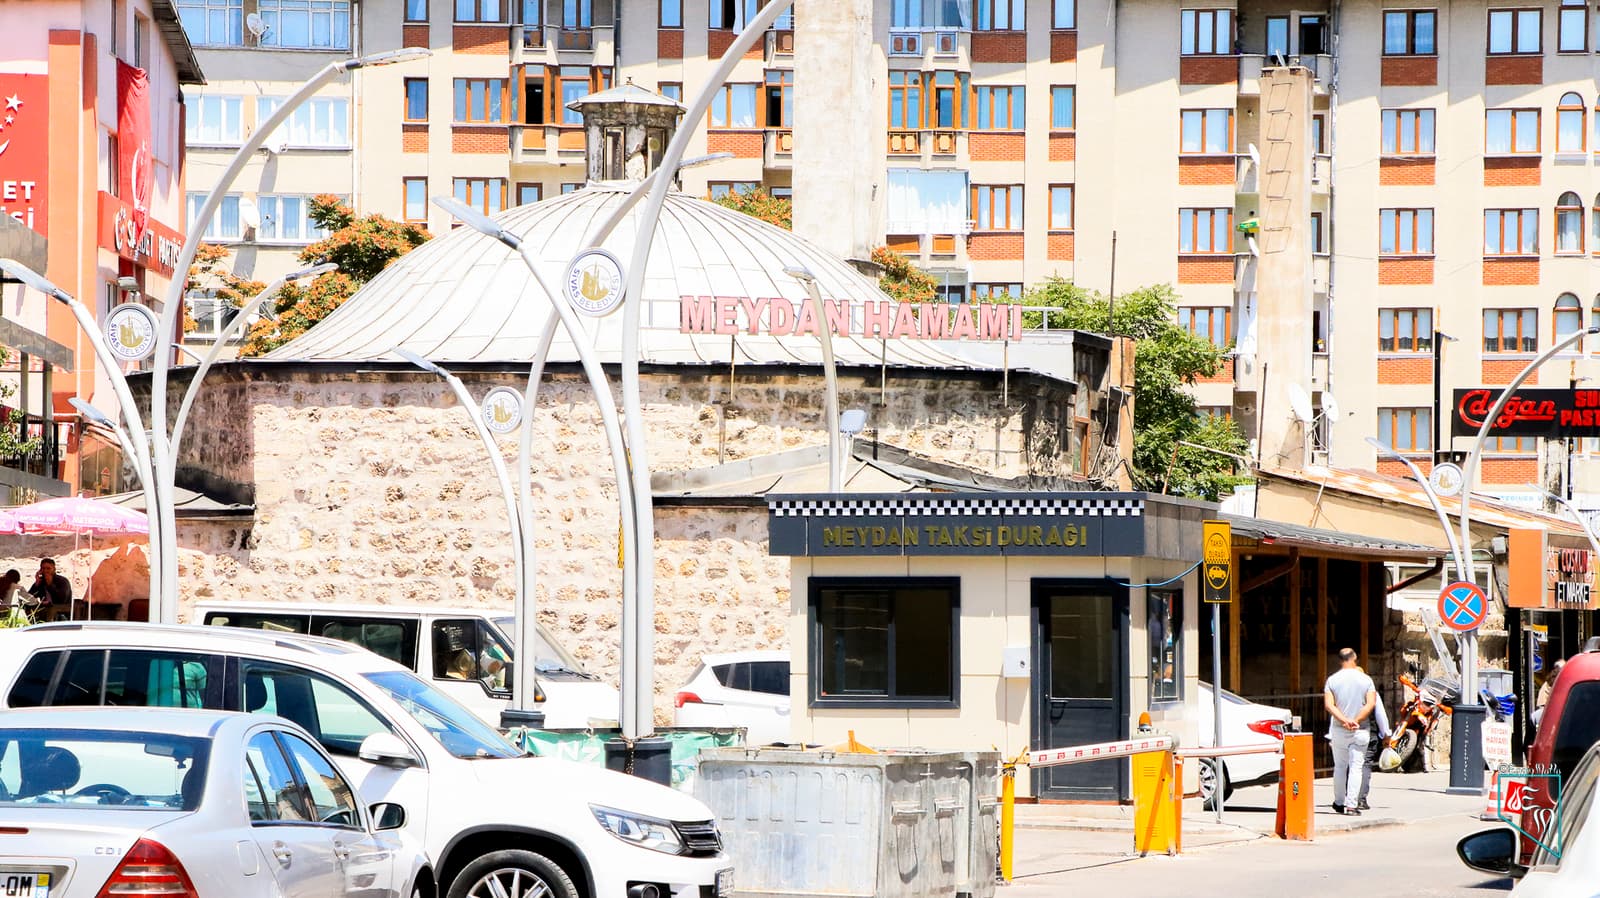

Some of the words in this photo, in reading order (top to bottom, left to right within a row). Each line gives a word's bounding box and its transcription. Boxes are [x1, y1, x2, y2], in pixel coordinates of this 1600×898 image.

[680, 295, 850, 337] MEYDAN
[863, 300, 1023, 341] HAMAMI
[823, 526, 919, 547] MEYDAN
[997, 523, 1088, 547] DURAĞI
